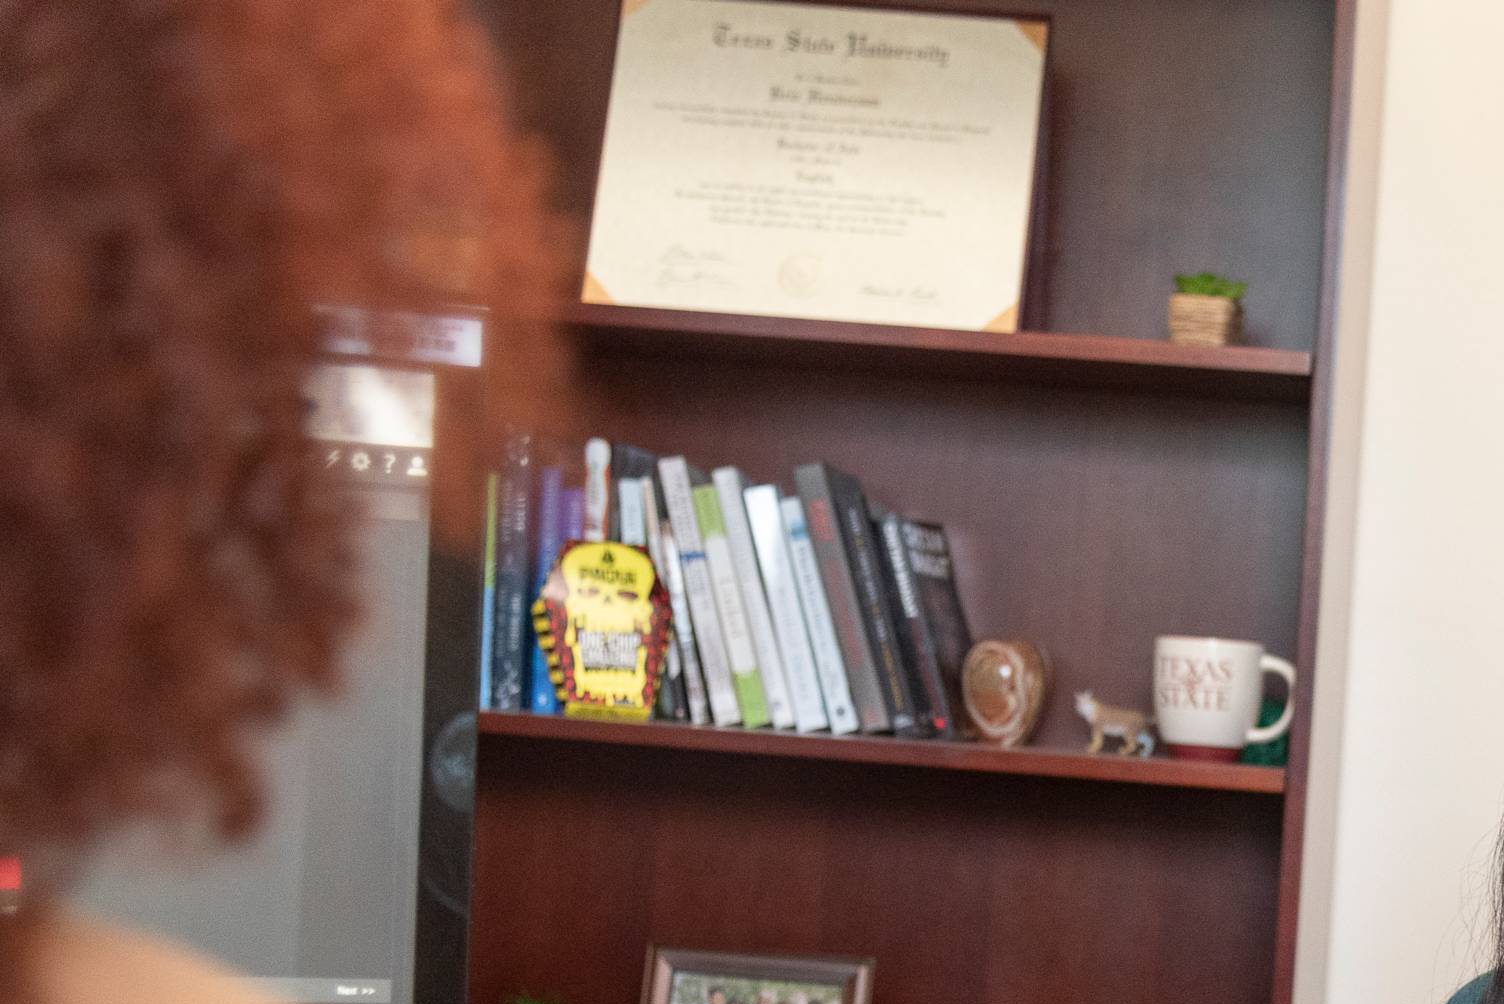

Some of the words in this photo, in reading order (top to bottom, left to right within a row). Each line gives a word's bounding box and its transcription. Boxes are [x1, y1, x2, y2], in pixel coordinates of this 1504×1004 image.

[713, 23, 774, 48] Texas
[785, 28, 835, 51] State
[846, 31, 950, 67] University
[1159, 656, 1233, 682] TEXAS
[1159, 685, 1231, 711] STATE
